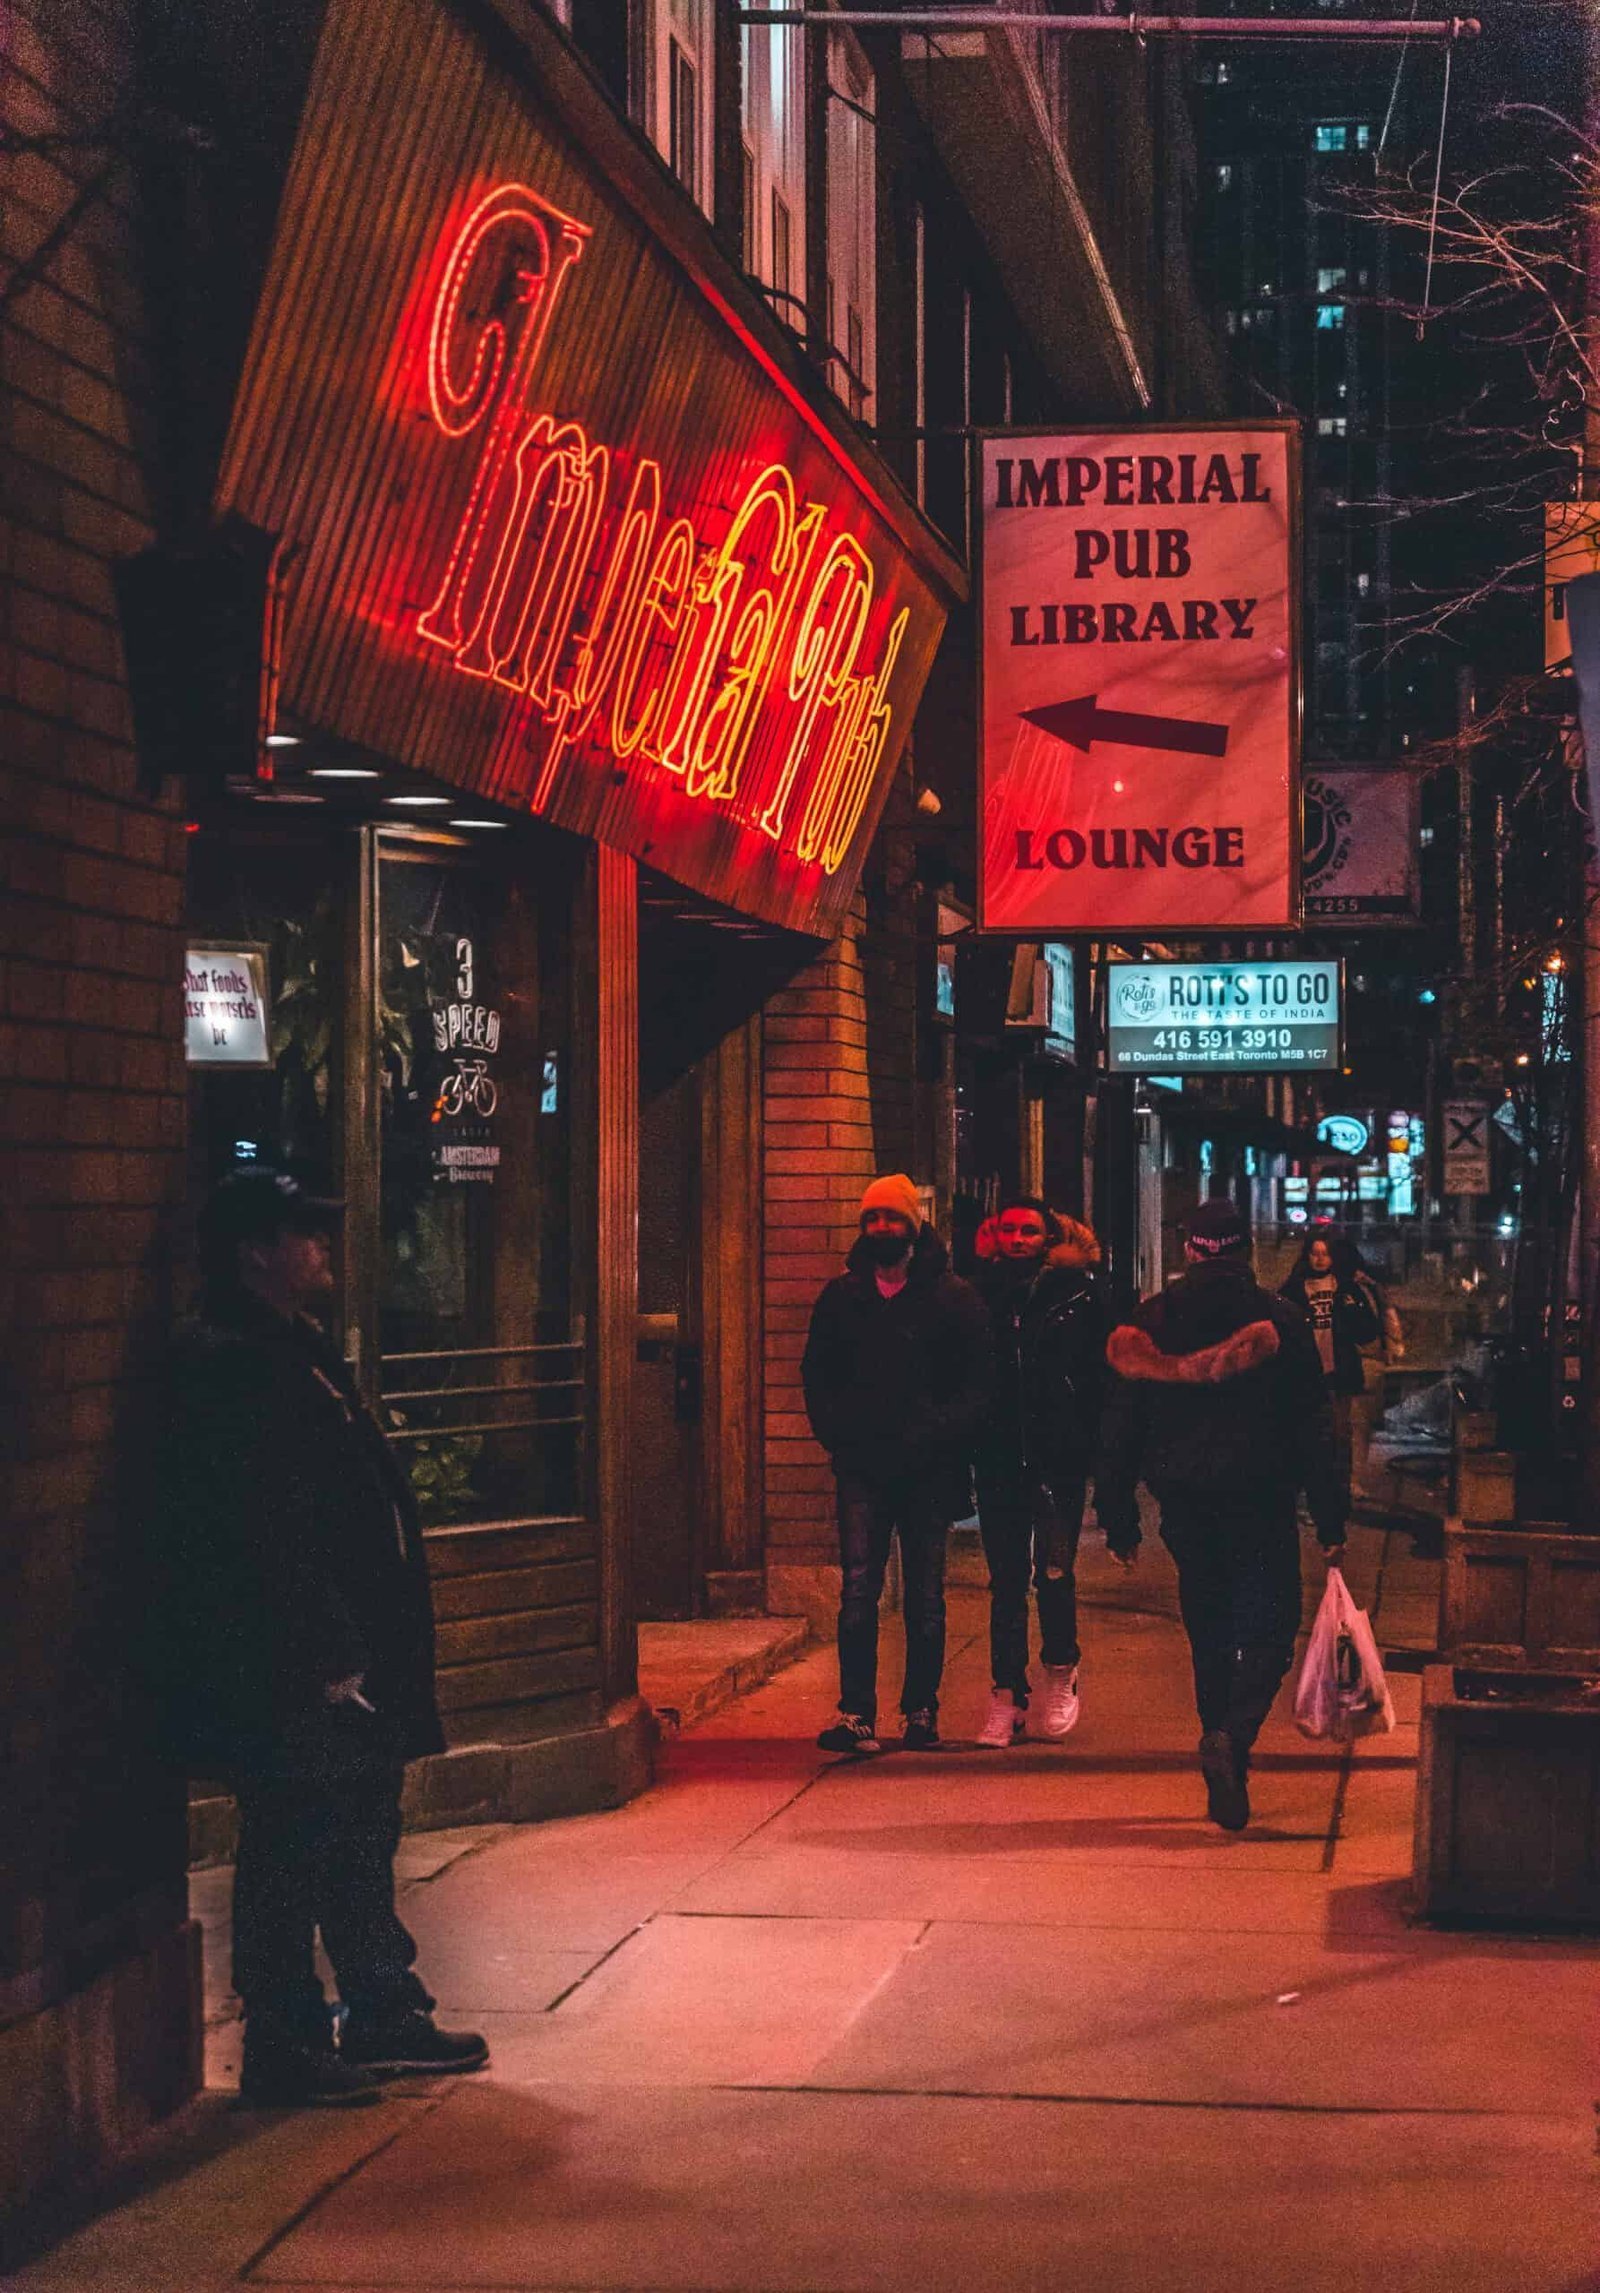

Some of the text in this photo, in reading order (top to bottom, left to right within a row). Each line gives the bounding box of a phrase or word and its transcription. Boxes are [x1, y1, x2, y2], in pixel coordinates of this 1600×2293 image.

[995, 453, 1271, 508] IMPERIAL
[1074, 528, 1191, 579] PUB
[1010, 598, 1258, 646] LIBRARY
[1014, 828, 1245, 871] LOUNGE
[211, 969, 248, 993] foods
[456, 938, 473, 999] 3
[1259, 974, 1288, 1006] TO
[1298, 973, 1329, 1005] GO
[433, 1003, 500, 1053] SPEED
[1171, 1008, 1325, 1020] THE TASTE OF INDIA
[1133, 1051, 1174, 1062] Dundas
[1176, 1050, 1208, 1061] Street
[1210, 1050, 1234, 1061] East
[1237, 1050, 1278, 1060] Toronto
[1307, 1049, 1328, 1058] 1C7
[1153, 1029, 1292, 1048] 416 591 3910
